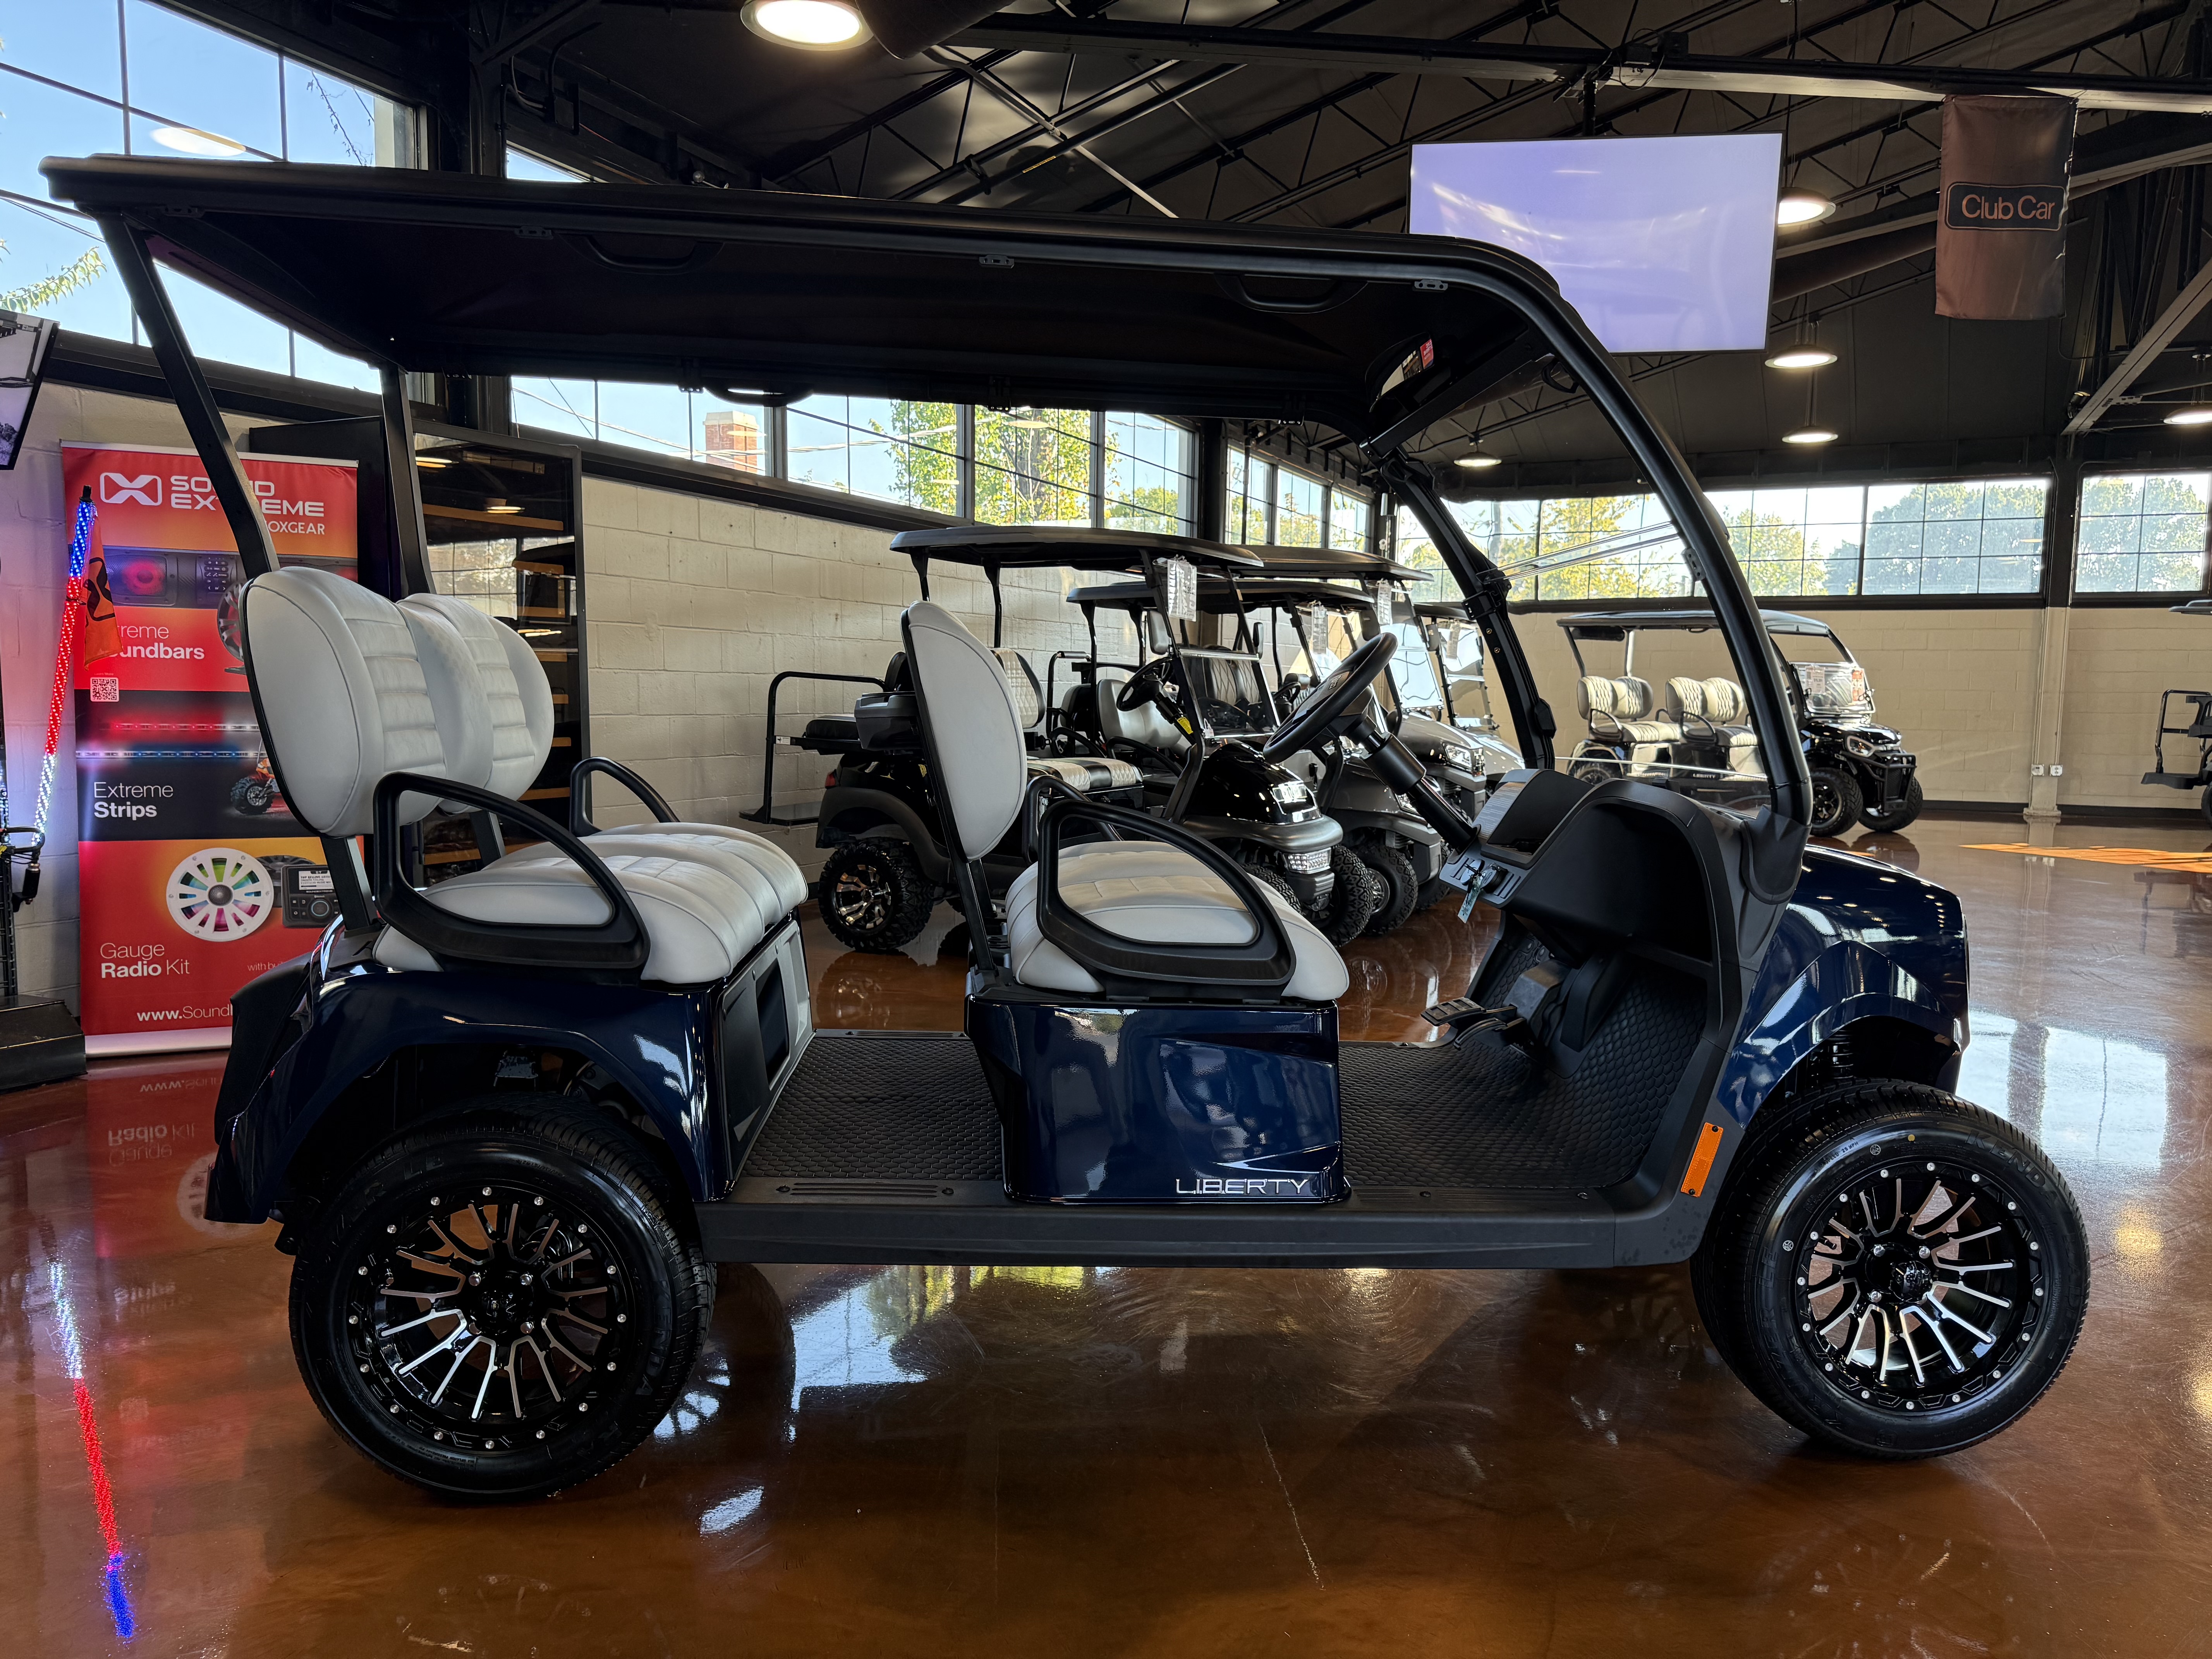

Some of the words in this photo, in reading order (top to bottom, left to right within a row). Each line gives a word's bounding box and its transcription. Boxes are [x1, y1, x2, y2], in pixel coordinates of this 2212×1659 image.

[1962, 194, 2013, 219] Club
[2018, 195, 2055, 219] Car
[170, 476, 275, 496] SOD
[171, 493, 324, 517] EXEME
[266, 520, 325, 535] OXGEAR
[117, 625, 169, 639] reme
[109, 642, 204, 659] undbars
[94, 782, 173, 798] Extreme
[94, 802, 157, 821] Strips
[100, 943, 165, 960] Gauge
[101, 961, 161, 978] Radio
[167, 959, 190, 975] Kit
[247, 962, 266, 971] with
[137, 1003, 232, 1021] www.Sound
[1965, 1130, 2058, 1208] KENDA
[1176, 1179, 1309, 1194] LIBERTY
